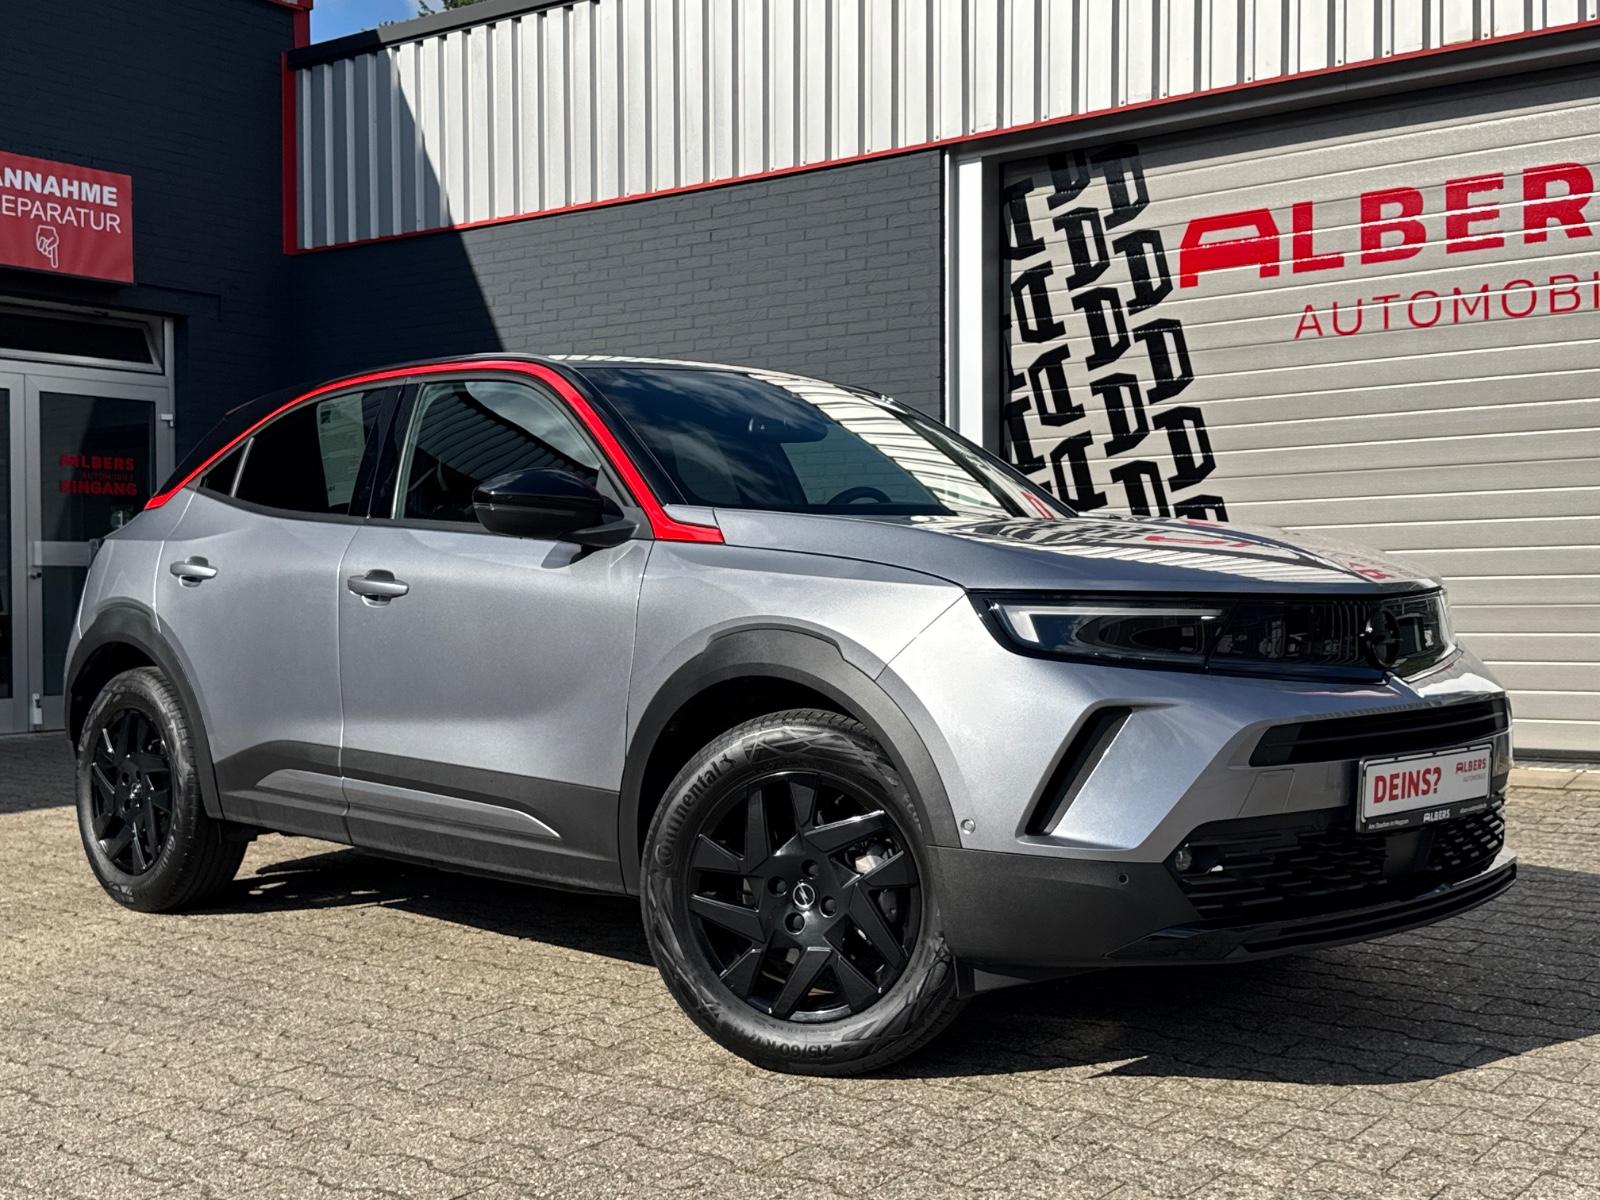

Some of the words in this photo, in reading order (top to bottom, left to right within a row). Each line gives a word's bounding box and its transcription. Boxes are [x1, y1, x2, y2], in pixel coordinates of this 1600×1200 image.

[0, 167, 118, 207] NNAHME
[61, 480, 137, 496] EINGANG
[1456, 758, 1487, 773] ALBERS
[1373, 766, 1442, 804] DEINS?
[1423, 809, 1450, 823] ALBERS
